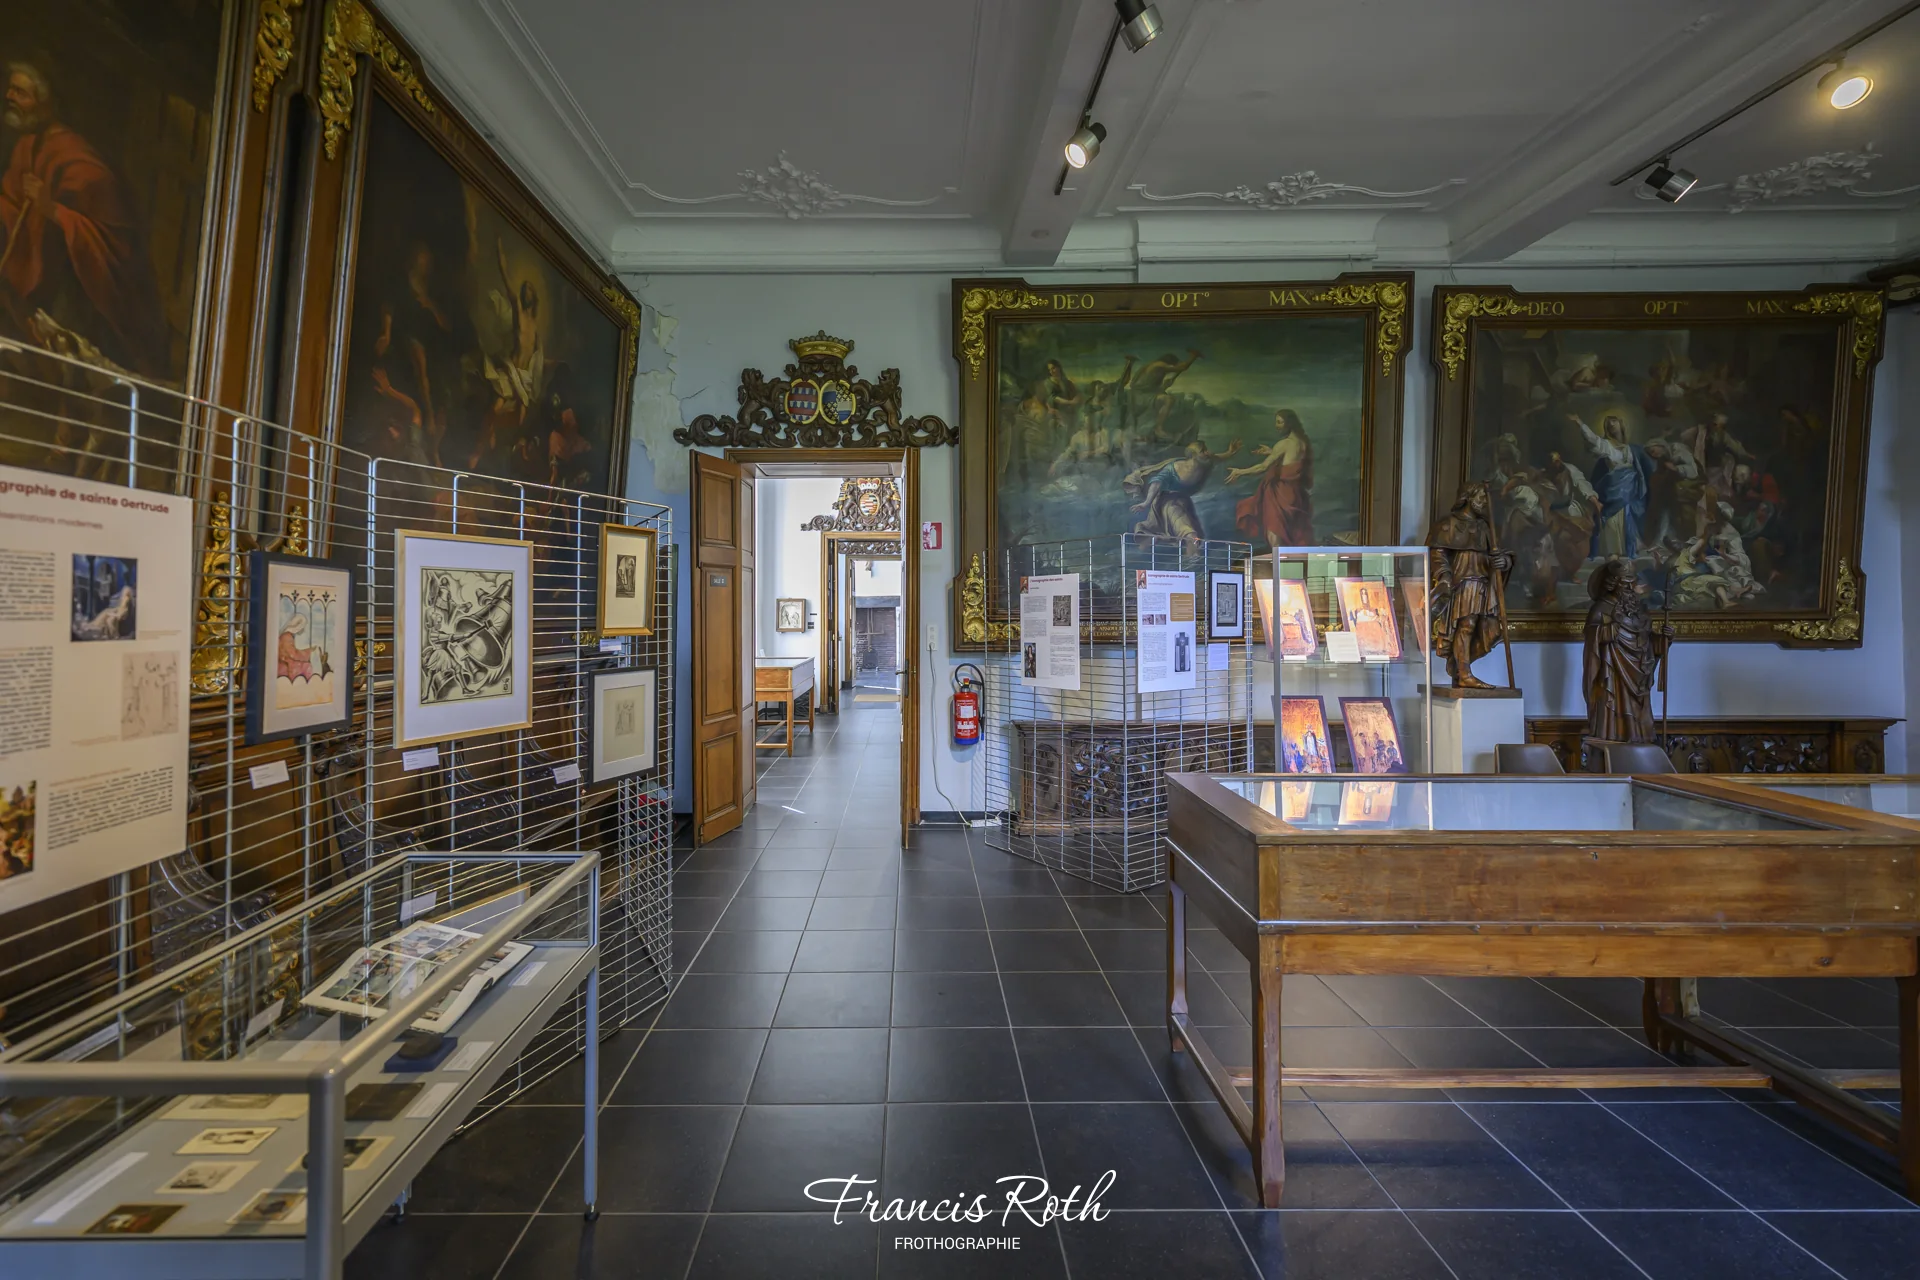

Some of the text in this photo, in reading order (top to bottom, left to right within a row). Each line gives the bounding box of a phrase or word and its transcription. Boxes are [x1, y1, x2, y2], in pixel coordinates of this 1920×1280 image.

[1053, 294, 1094, 310] DEO
[1528, 301, 1565, 316] DEO
[59, 489, 77, 501] de
[79, 492, 118, 507] sainte
[120, 497, 169, 514] Gertrude
